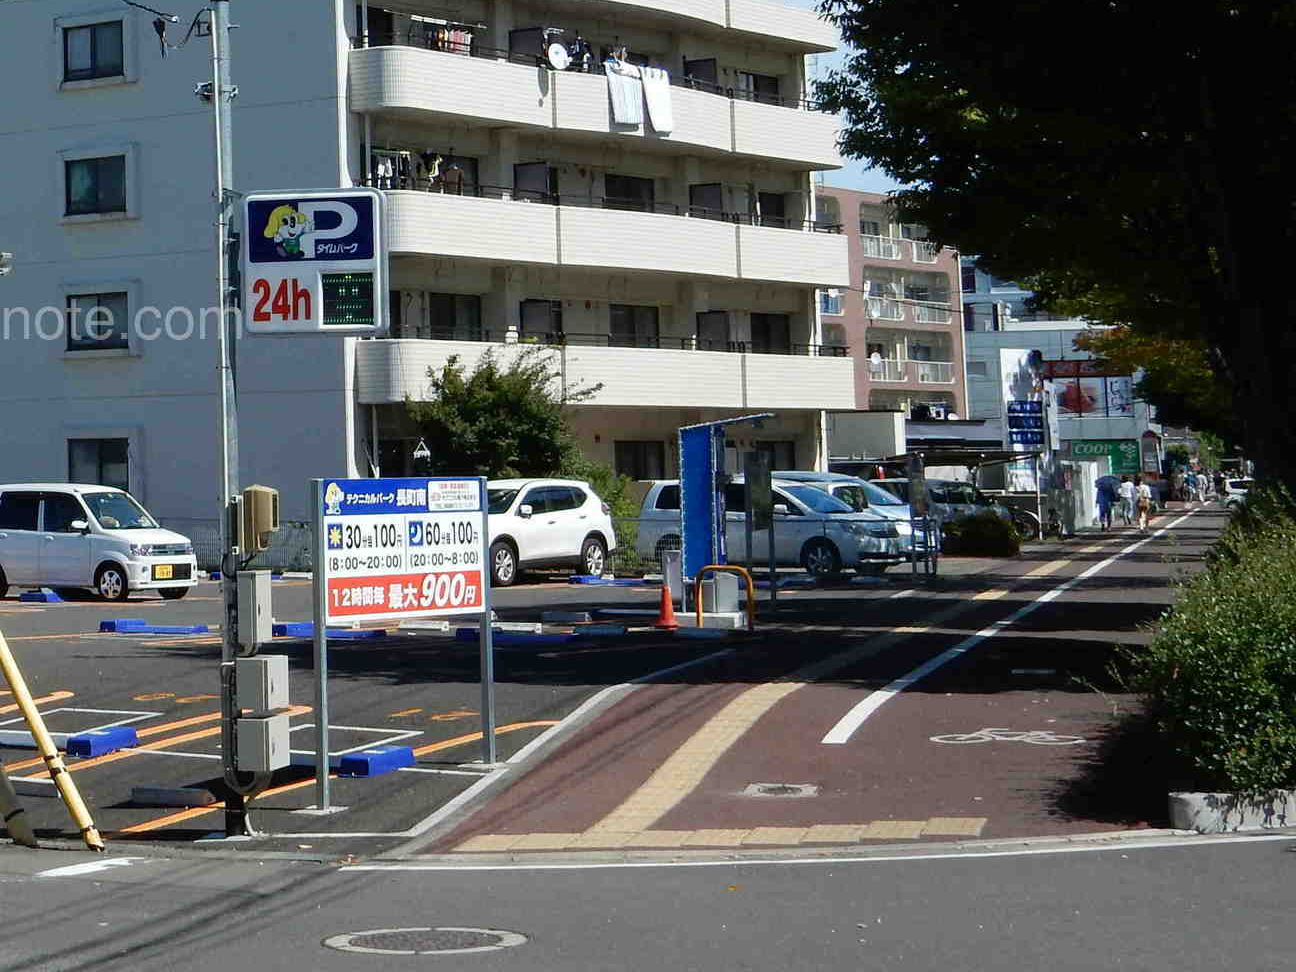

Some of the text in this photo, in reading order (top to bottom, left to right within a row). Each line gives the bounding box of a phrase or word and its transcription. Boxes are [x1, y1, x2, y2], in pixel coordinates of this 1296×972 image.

[299, 201, 358, 258] P
[253, 278, 312, 322] 24h
[346, 492, 395, 505] テクニカルパーク
